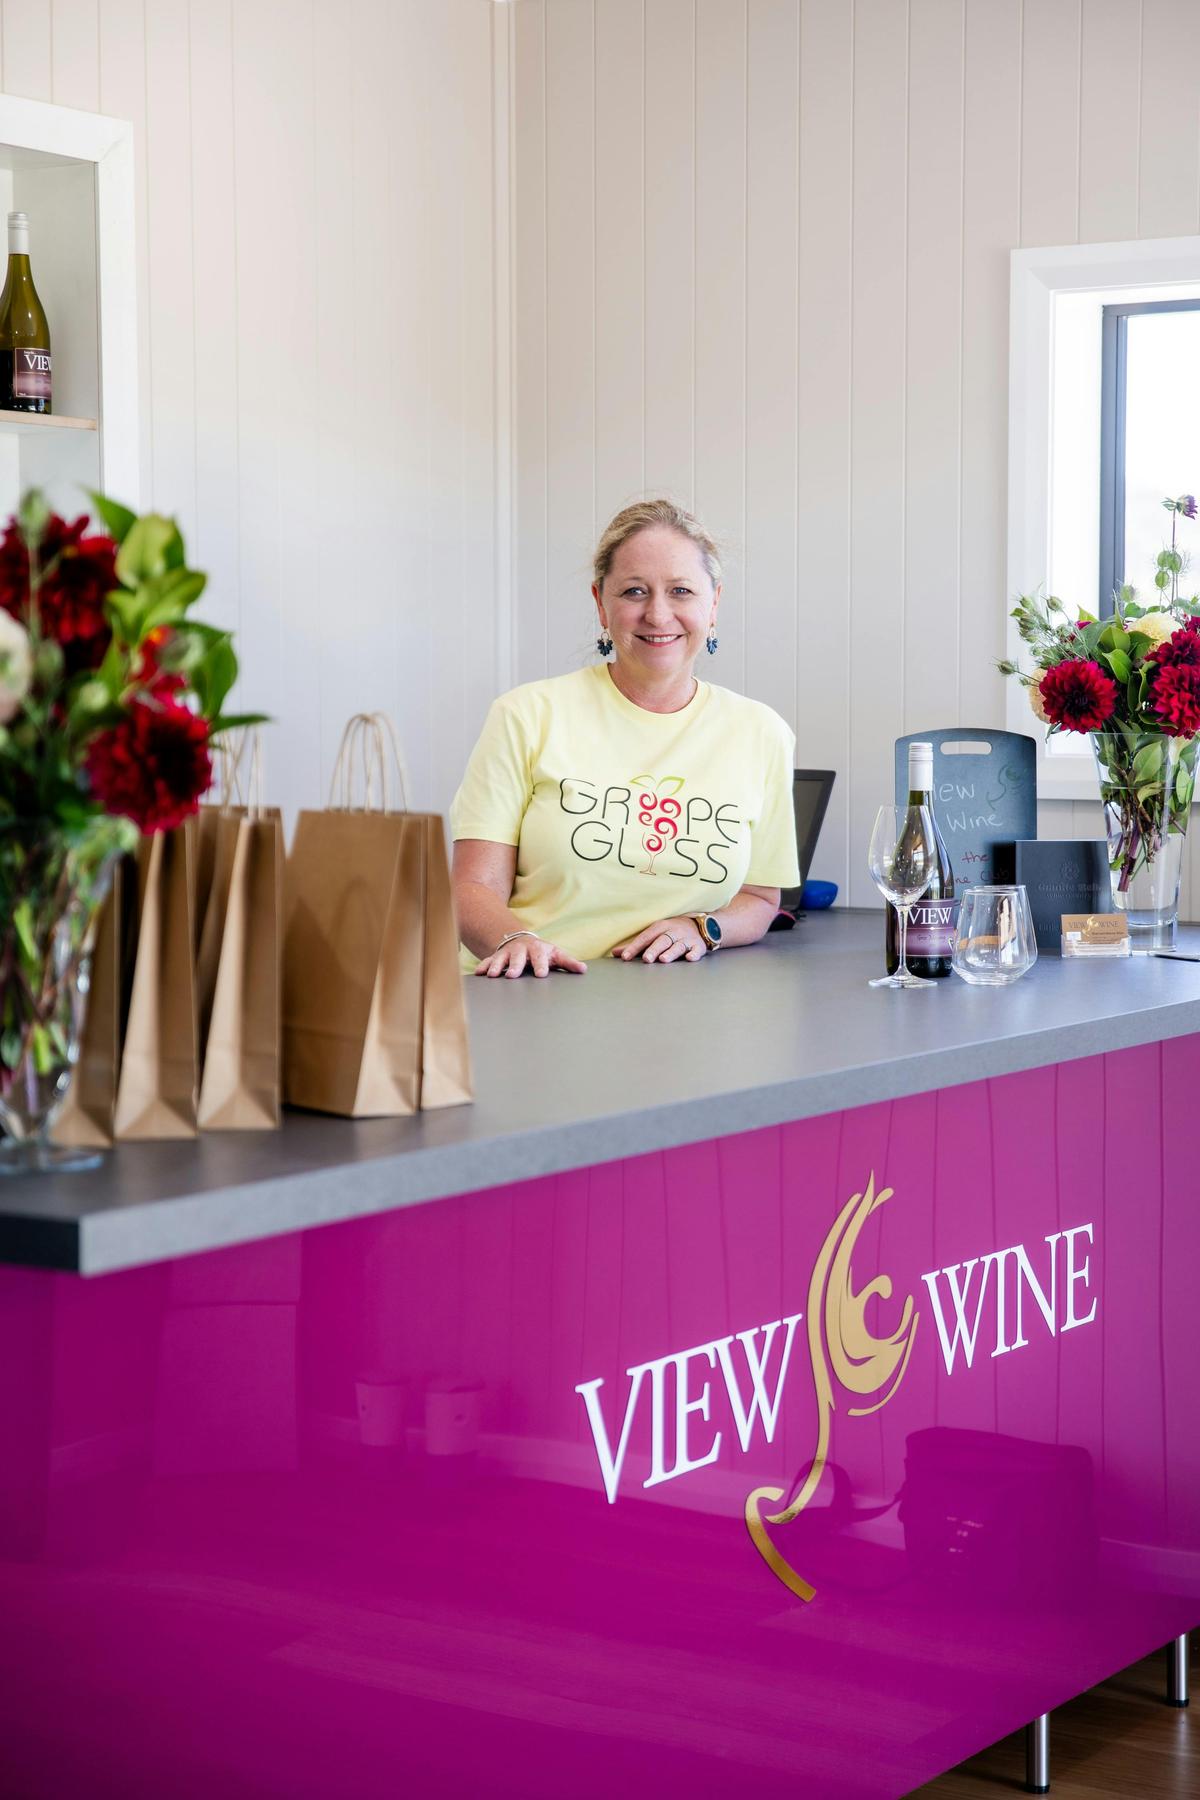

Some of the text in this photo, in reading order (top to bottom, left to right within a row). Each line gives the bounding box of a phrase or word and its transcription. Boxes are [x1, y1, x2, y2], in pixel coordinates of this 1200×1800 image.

[933, 779, 976, 802] iew
[559, 777, 740, 845] GRPE
[946, 811, 1004, 833] Wine
[571, 820, 730, 884] GLSS
[961, 851, 990, 864] the
[908, 906, 952, 925] VIEW
[574, 1222, 1098, 1505] VIEW WINE
